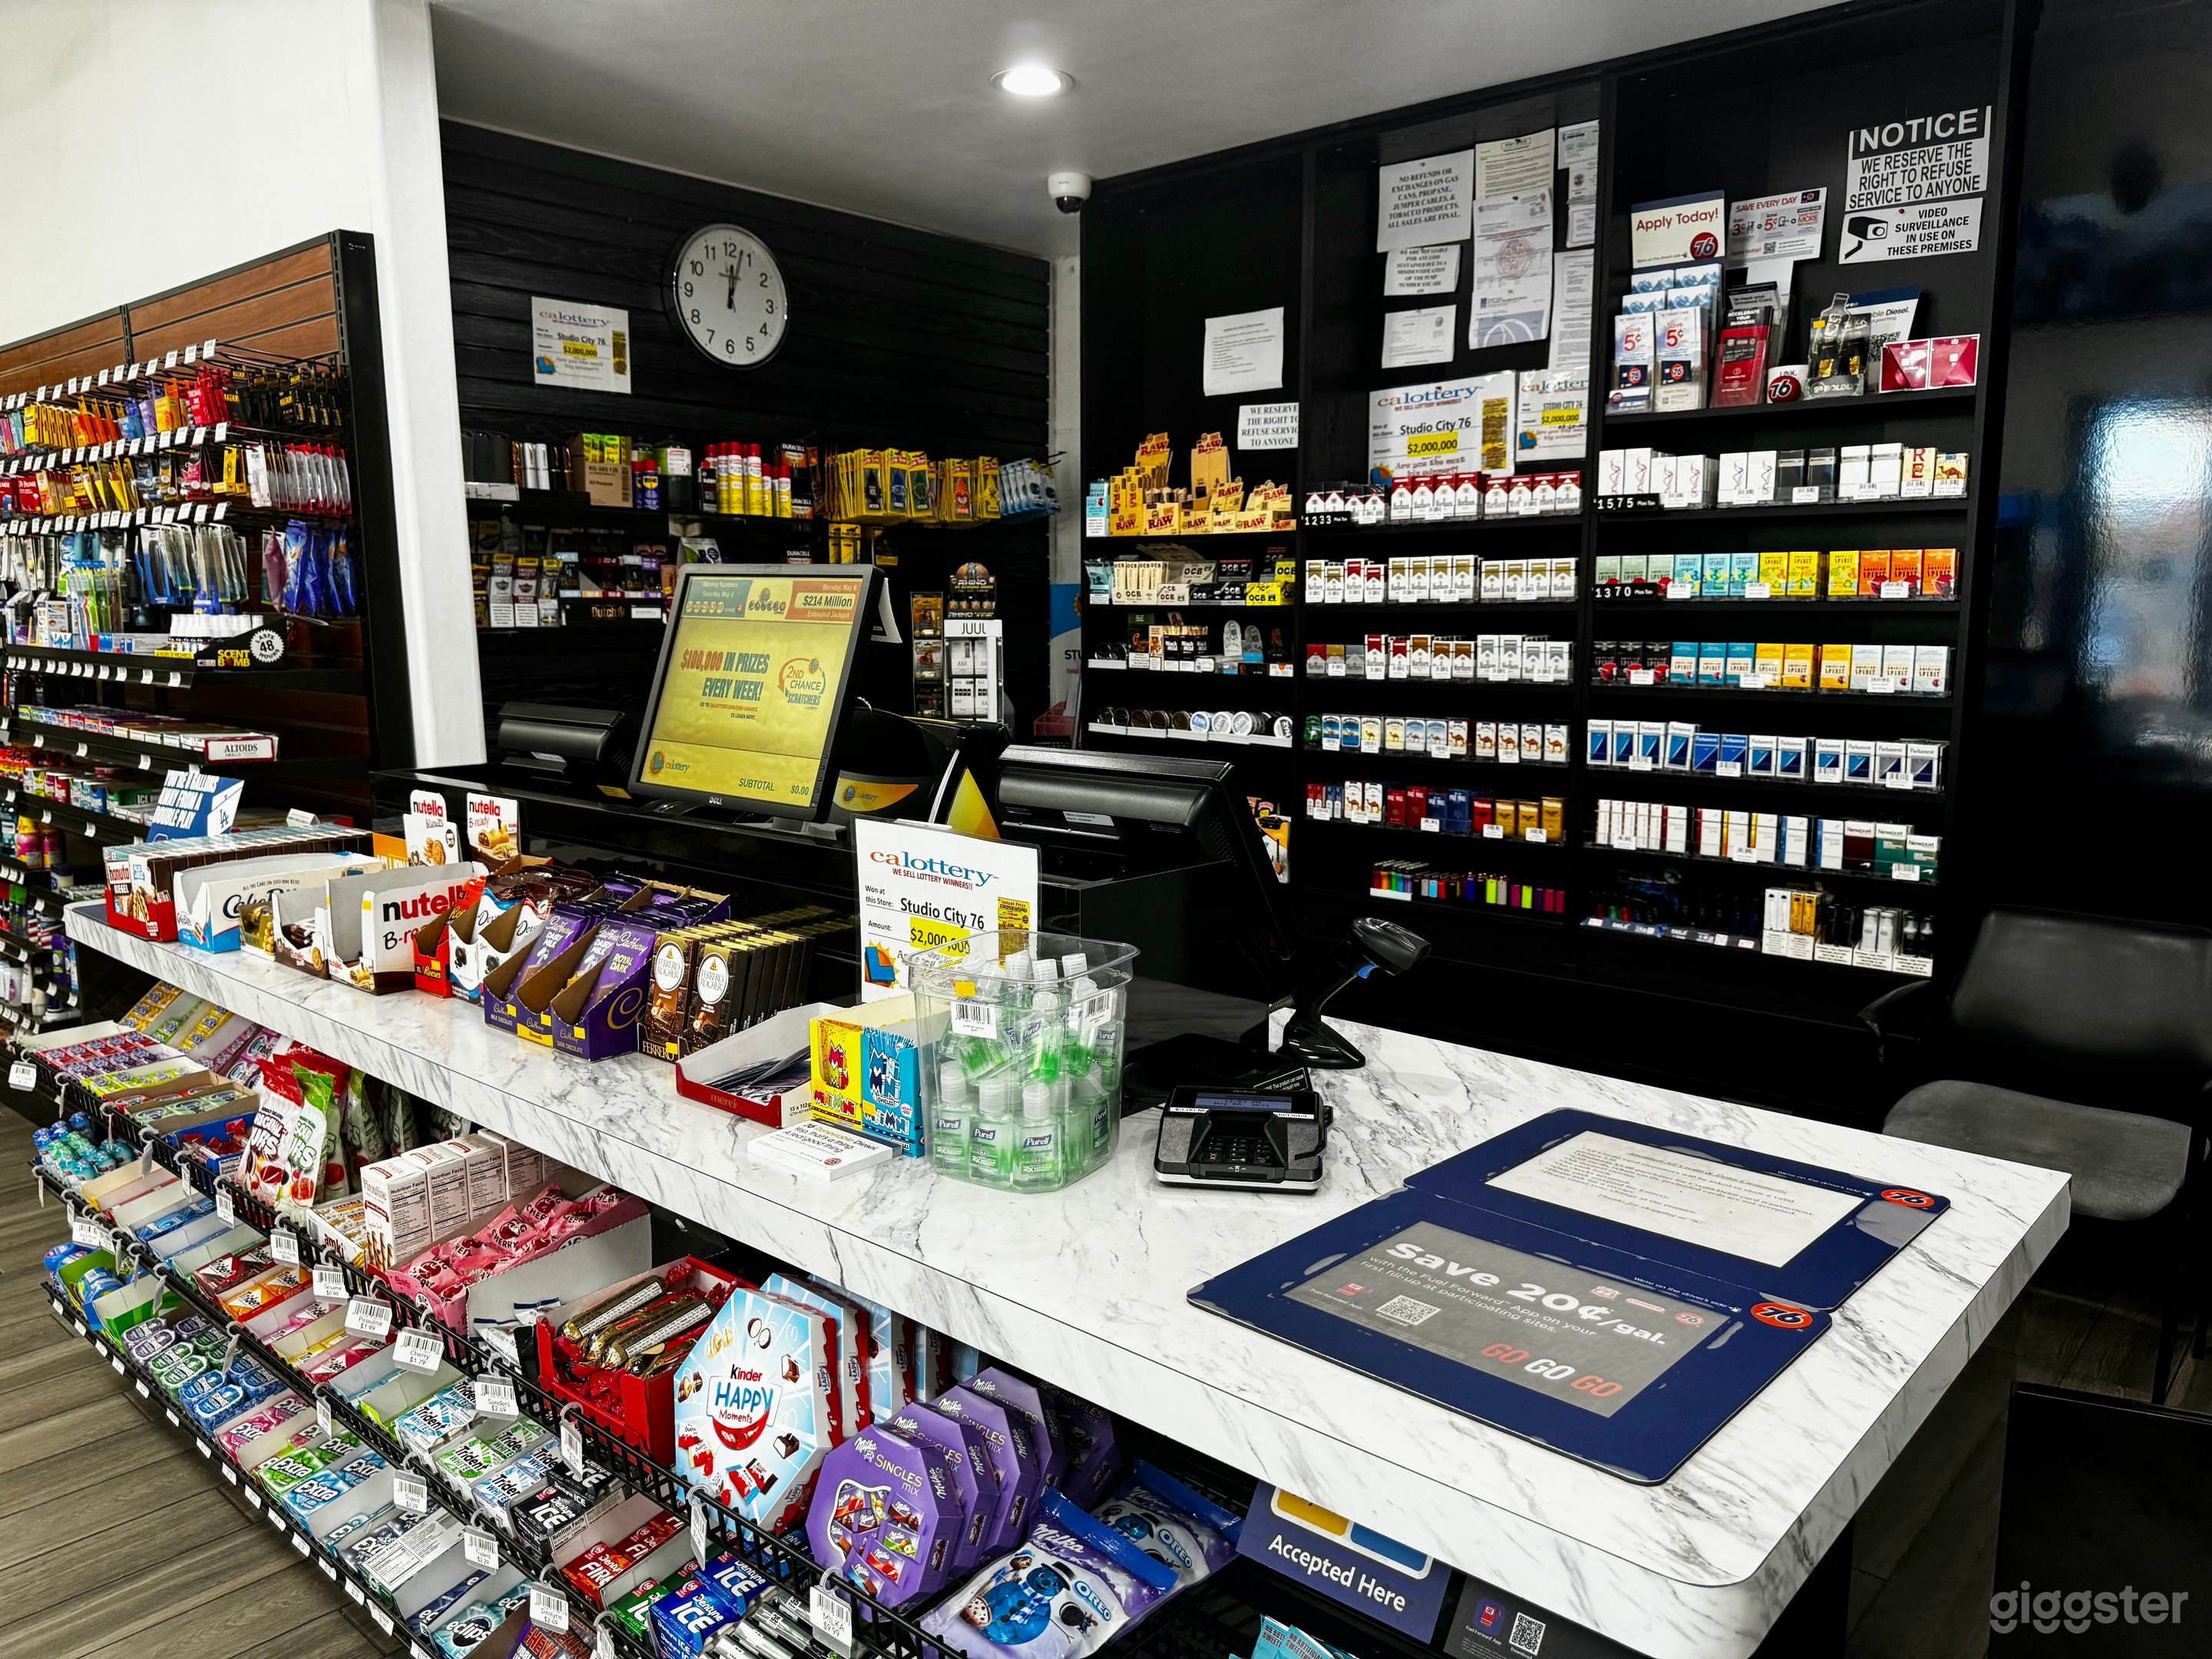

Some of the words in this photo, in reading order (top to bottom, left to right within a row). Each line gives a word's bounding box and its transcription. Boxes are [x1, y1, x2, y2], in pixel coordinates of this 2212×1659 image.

[1859, 108, 1979, 152] NOTICE
[1861, 157, 1880, 174] WE
[1884, 147, 1943, 171] RESERVE
[1947, 141, 1973, 160] THE
[1399, 174, 1409, 182] NO
[1410, 170, 1442, 181] REFUNDS
[1859, 171, 1897, 191] RIGHT
[1901, 168, 1917, 184] TO
[1920, 159, 1972, 181] REFUSE
[1392, 180, 1433, 193] EXCHANGES
[1434, 177, 1444, 186] ON
[1445, 175, 1459, 184] GAS
[1849, 187, 1902, 209] SERVICE
[1906, 184, 1922, 200] TO
[1926, 175, 1981, 198] ANYONE
[1392, 199, 1421, 210] JUMPER
[1735, 204, 1755, 213] SAVE
[1756, 199, 1780, 210] EVERY
[1781, 196, 1798, 206] DAY
[1389, 207, 1421, 220] TOBACCO
[1636, 215, 1672, 232] Apply
[1676, 207, 1719, 225] Today!
[1919, 207, 1948, 219] VIDEO
[1388, 220, 1399, 229] ALL
[1402, 217, 1421, 227] SALES
[1895, 216, 1969, 233] SURVEILLANCE
[1906, 233, 1916, 243] IN
[1919, 232, 1939, 242] USE
[1941, 230, 1955, 240] ON
[704, 245, 716, 260] 11
[724, 242, 737, 257] 12
[1887, 246, 1919, 257] THESE
[1920, 240, 1972, 253] PREMISES
[690, 260, 704, 276] 10
[746, 253, 752, 268] 1
[760, 273, 769, 288] 2
[684, 282, 694, 297] 9
[766, 300, 774, 314] 3
[539, 310, 608, 326] calottery
[691, 310, 701, 324] 8
[707, 329, 715, 344] 7
[760, 323, 769, 336] 4
[557, 332, 579, 343] Studio
[581, 335, 596, 346] City
[597, 337, 606, 346] 76
[726, 339, 735, 354] 6
[746, 337, 754, 352] 5
[563, 345, 598, 358] $2,000,000
[1377, 386, 1479, 408] calottery
[1263, 405, 1298, 414] RESERVE
[1263, 416, 1287, 425] RIGHT
[1400, 422, 1432, 435] Studio
[1435, 419, 1456, 434] City
[1459, 417, 1472, 428] 76
[1242, 428, 1270, 436] REFUSE
[1263, 437, 1294, 445] ANYONE
[1407, 439, 1458, 454] $2,000,000
[1218, 484, 1241, 498] RAW
[803, 595, 823, 607] $214
[824, 596, 853, 608] Million
[962, 622, 986, 635] JUUL
[217, 649, 250, 658] SCENT
[260, 640, 274, 652] 48
[681, 648, 724, 671] $100,000
[724, 651, 736, 672] IN
[737, 653, 770, 674] PRIZES
[786, 665, 804, 679] 2ND
[702, 677, 733, 698] EVERY
[733, 680, 764, 701] WEEK!
[790, 680, 822, 690] CHANCE
[787, 694, 822, 706] SCRATCHERS
[224, 743, 258, 753] ALTOIDS
[738, 778, 775, 793] SUBTOTAL
[790, 785, 810, 796] $0.00
[413, 800, 444, 817] nutella
[469, 816, 490, 828] B-ready
[1877, 828, 1905, 836] Newport
[869, 851, 993, 886] calottery
[892, 868, 902, 876] WE
[903, 869, 916, 879] SELL
[917, 873, 942, 884] LOTTERY
[942, 877, 973, 891] WINNERS!!
[865, 885, 879, 894] Won
[866, 896, 876, 904] this
[877, 898, 893, 908] Store:
[900, 897, 940, 919] Studio
[944, 906, 967, 929] City
[970, 912, 985, 929] 76
[868, 920, 892, 932] Amount:
[545, 932, 563, 940] DAIRY
[615, 931, 647, 955] Cadbury
[543, 939, 557, 949] MILK
[614, 953, 633, 965] ROYAL
[610, 962, 628, 974] DARK
[700, 970, 724, 982] FERRERO
[700, 979, 724, 992] ROCHER
[1026, 1135, 1051, 1147] Purell
[1386, 1242, 1500, 1286] Save
[1360, 1261, 1383, 1273] first
[1386, 1270, 1421, 1286] fill-up
[1422, 1283, 1437, 1292] at
[1438, 1289, 1522, 1321] participating
[1523, 1318, 1557, 1333] sites.
[1369, 1256, 1396, 1268] with
[1399, 1266, 1418, 1276] the
[1419, 1273, 1449, 1286] Fuel
[1511, 1305, 1540, 1320] App
[1542, 1316, 1561, 1325] on
[1562, 1323, 1597, 1336] your
[358, 1316, 383, 1326] Pirouline
[1761, 1306, 1806, 1324] 76
[409, 1349, 430, 1359] Cherry
[729, 1363, 763, 1383] Kinder
[1480, 1343, 1530, 1363] GO
[1524, 1358, 1575, 1380] GO
[1571, 1375, 1623, 1398] GO
[487, 1399, 510, 1407] Sanders
[714, 1382, 775, 1412] HAPPY
[414, 1405, 449, 1431] Trident
[718, 1409, 754, 1425] Moments
[853, 1435, 878, 1453] Milka
[272, 1457, 313, 1480] Extra
[876, 1453, 923, 1488] SINGLES
[901, 1480, 920, 1498] mix
[1031, 1522, 1085, 1555] Milka
[1267, 1533, 1353, 1588] Accepted
[1356, 1573, 1408, 1612] Here
[691, 1591, 725, 1622] Dentyne
[1071, 1578, 1114, 1624] OREO
[669, 1601, 714, 1634] ICE
[822, 1612, 846, 1631] MILKA
[823, 1624, 841, 1638] $9.99
